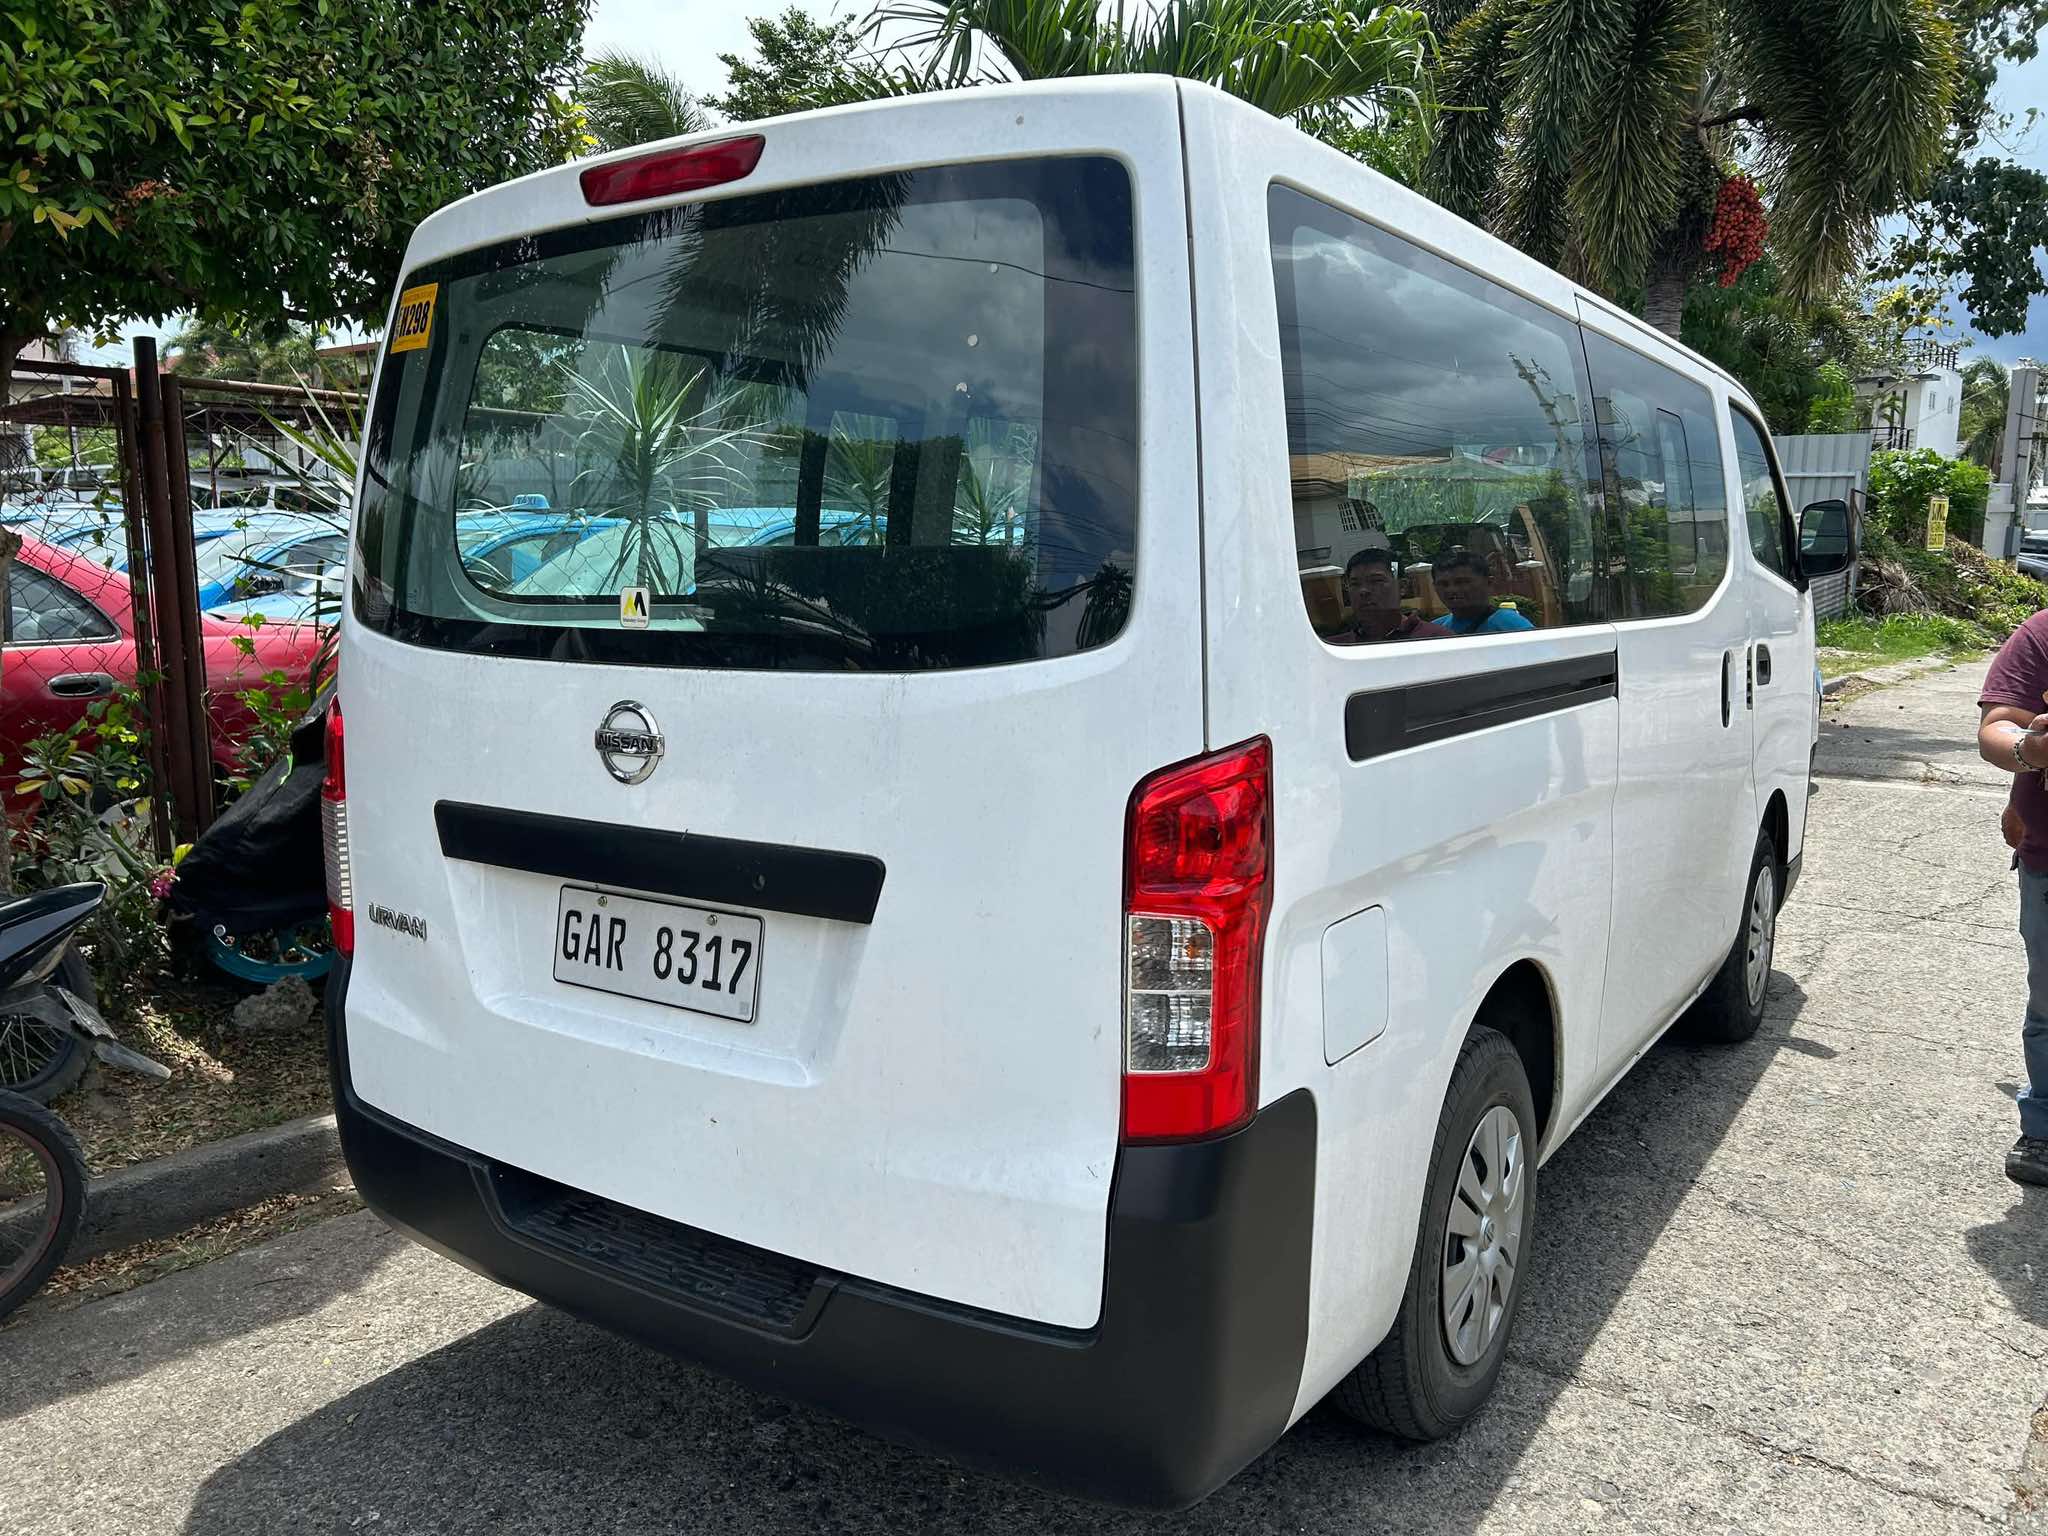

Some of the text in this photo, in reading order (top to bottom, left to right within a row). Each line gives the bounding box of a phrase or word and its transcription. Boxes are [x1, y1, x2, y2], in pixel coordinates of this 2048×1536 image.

[598, 734, 654, 751] NISSAN
[368, 902, 428, 942] URVAN
[562, 909, 752, 995] GAR 8317
